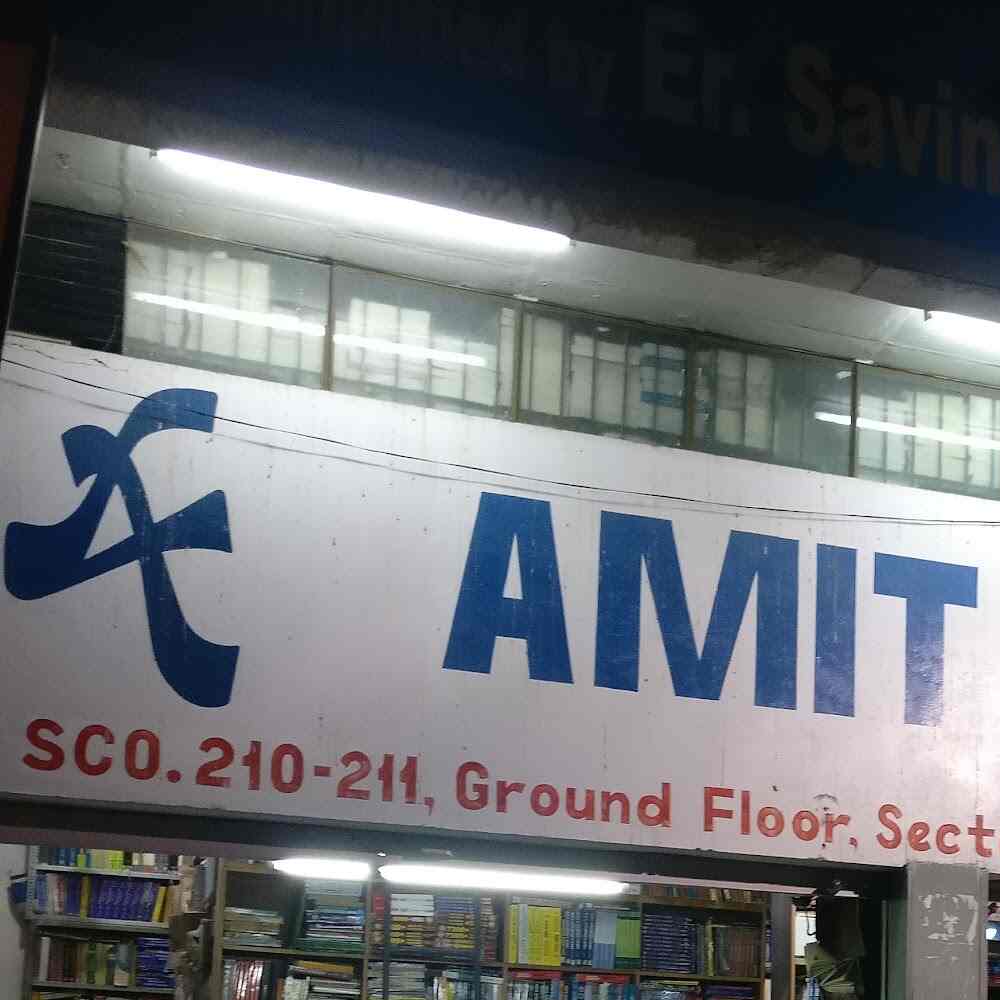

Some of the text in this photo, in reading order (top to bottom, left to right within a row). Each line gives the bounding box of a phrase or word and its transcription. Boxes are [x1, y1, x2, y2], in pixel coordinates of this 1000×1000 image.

[786, 44, 1000, 195] Savin
[443, 492, 977, 726] AMIT
[456, 761, 671, 827] Ground
